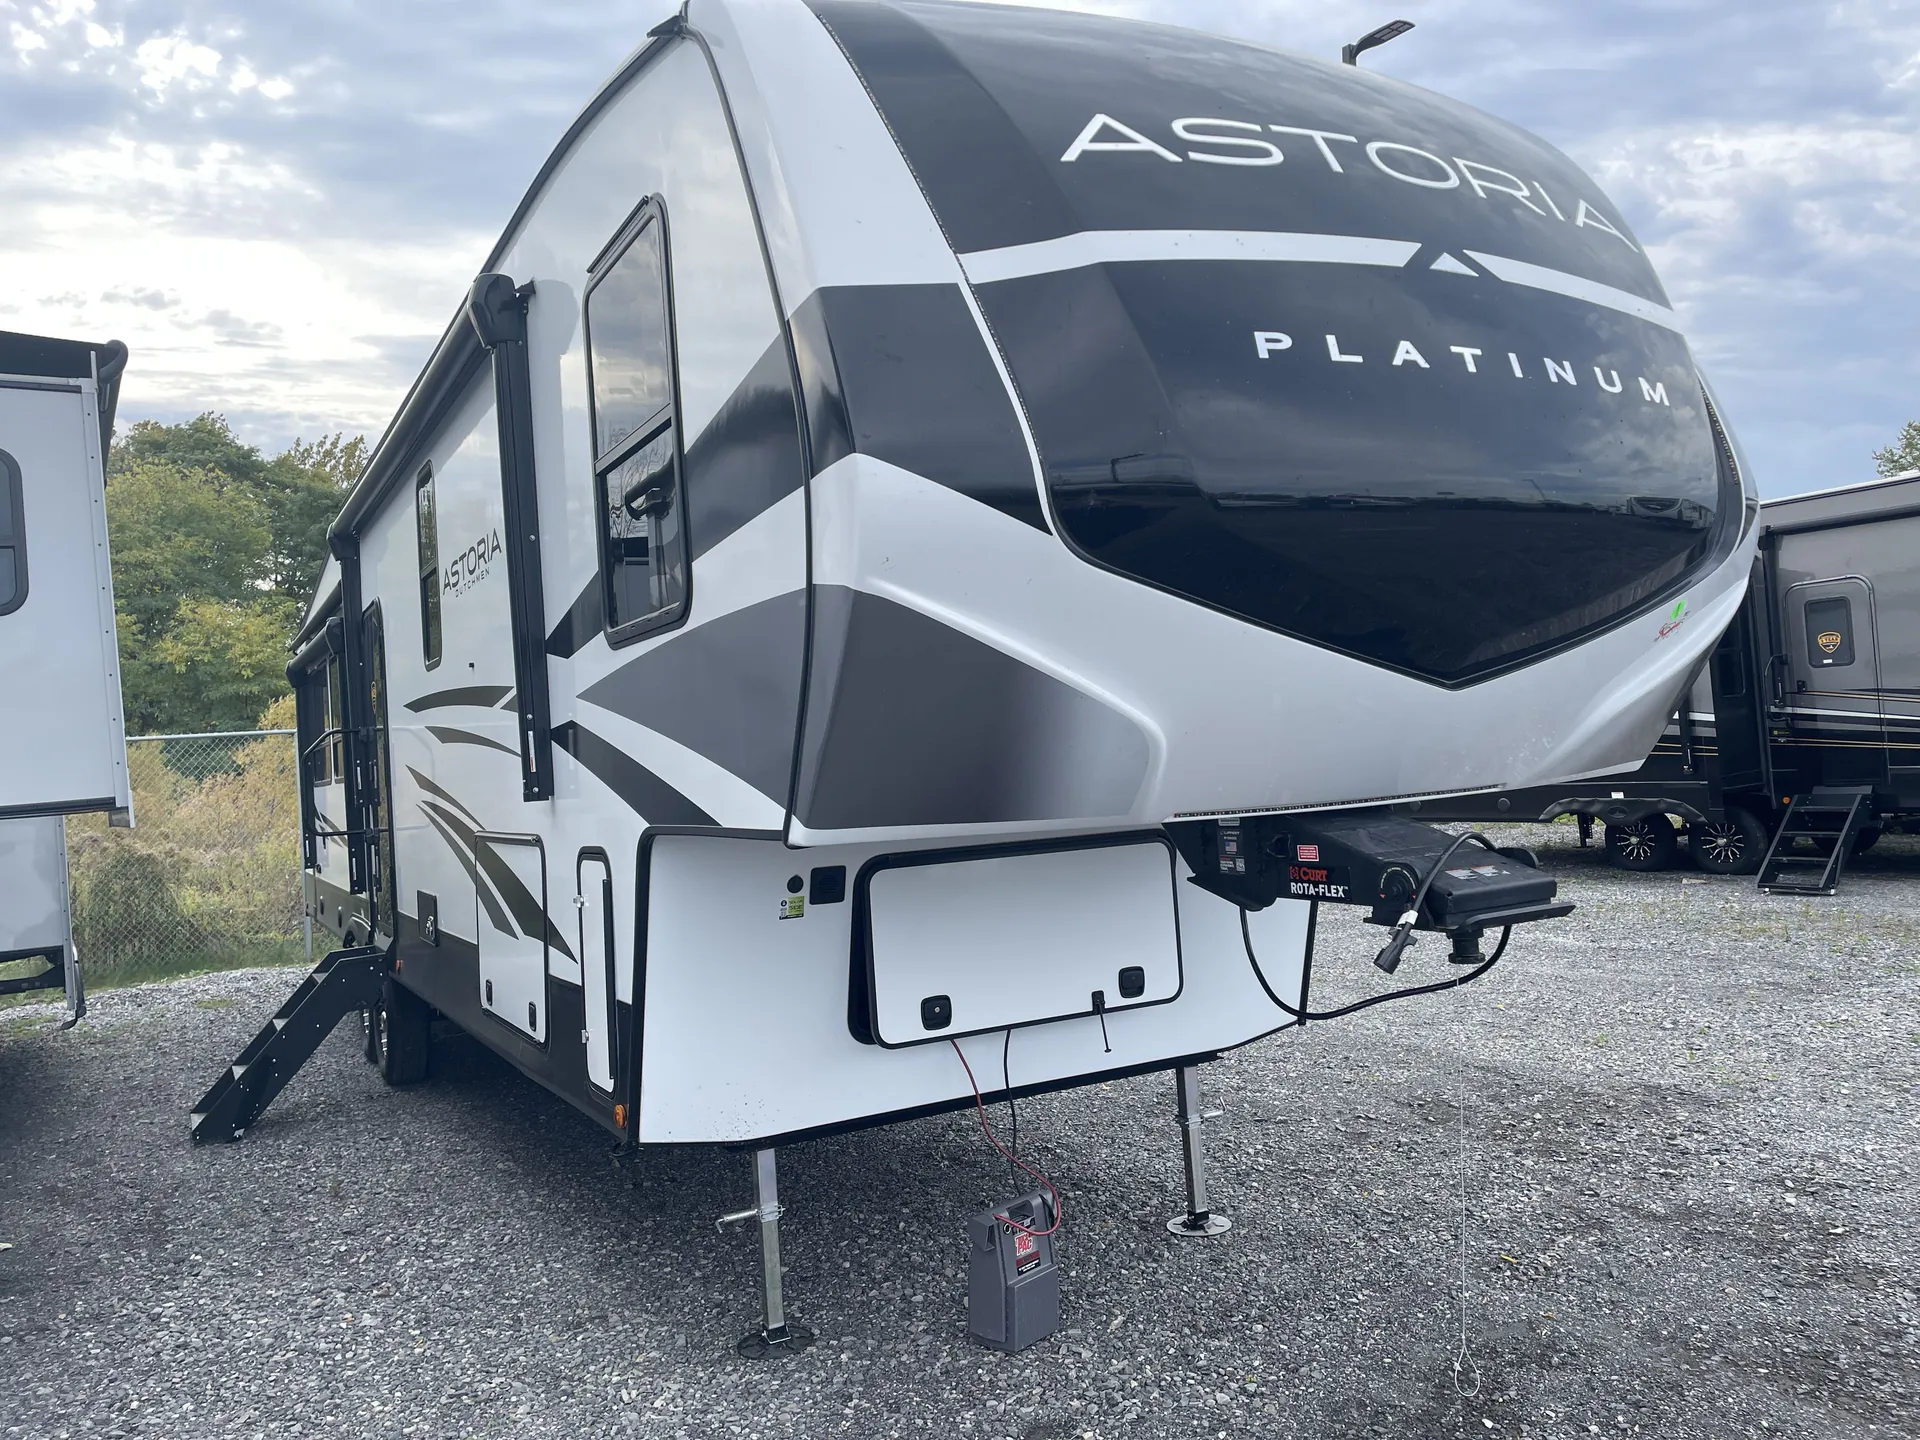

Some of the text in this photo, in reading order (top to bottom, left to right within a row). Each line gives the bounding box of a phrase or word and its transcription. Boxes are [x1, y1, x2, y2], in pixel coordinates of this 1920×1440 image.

[1060, 112, 1643, 255] ASTORIA
[1253, 330, 1671, 407] PLATINUM
[442, 527, 502, 596] ASTORIA
[455, 566, 490, 598] DUTCHMEN
[1300, 866, 1327, 882] CURT
